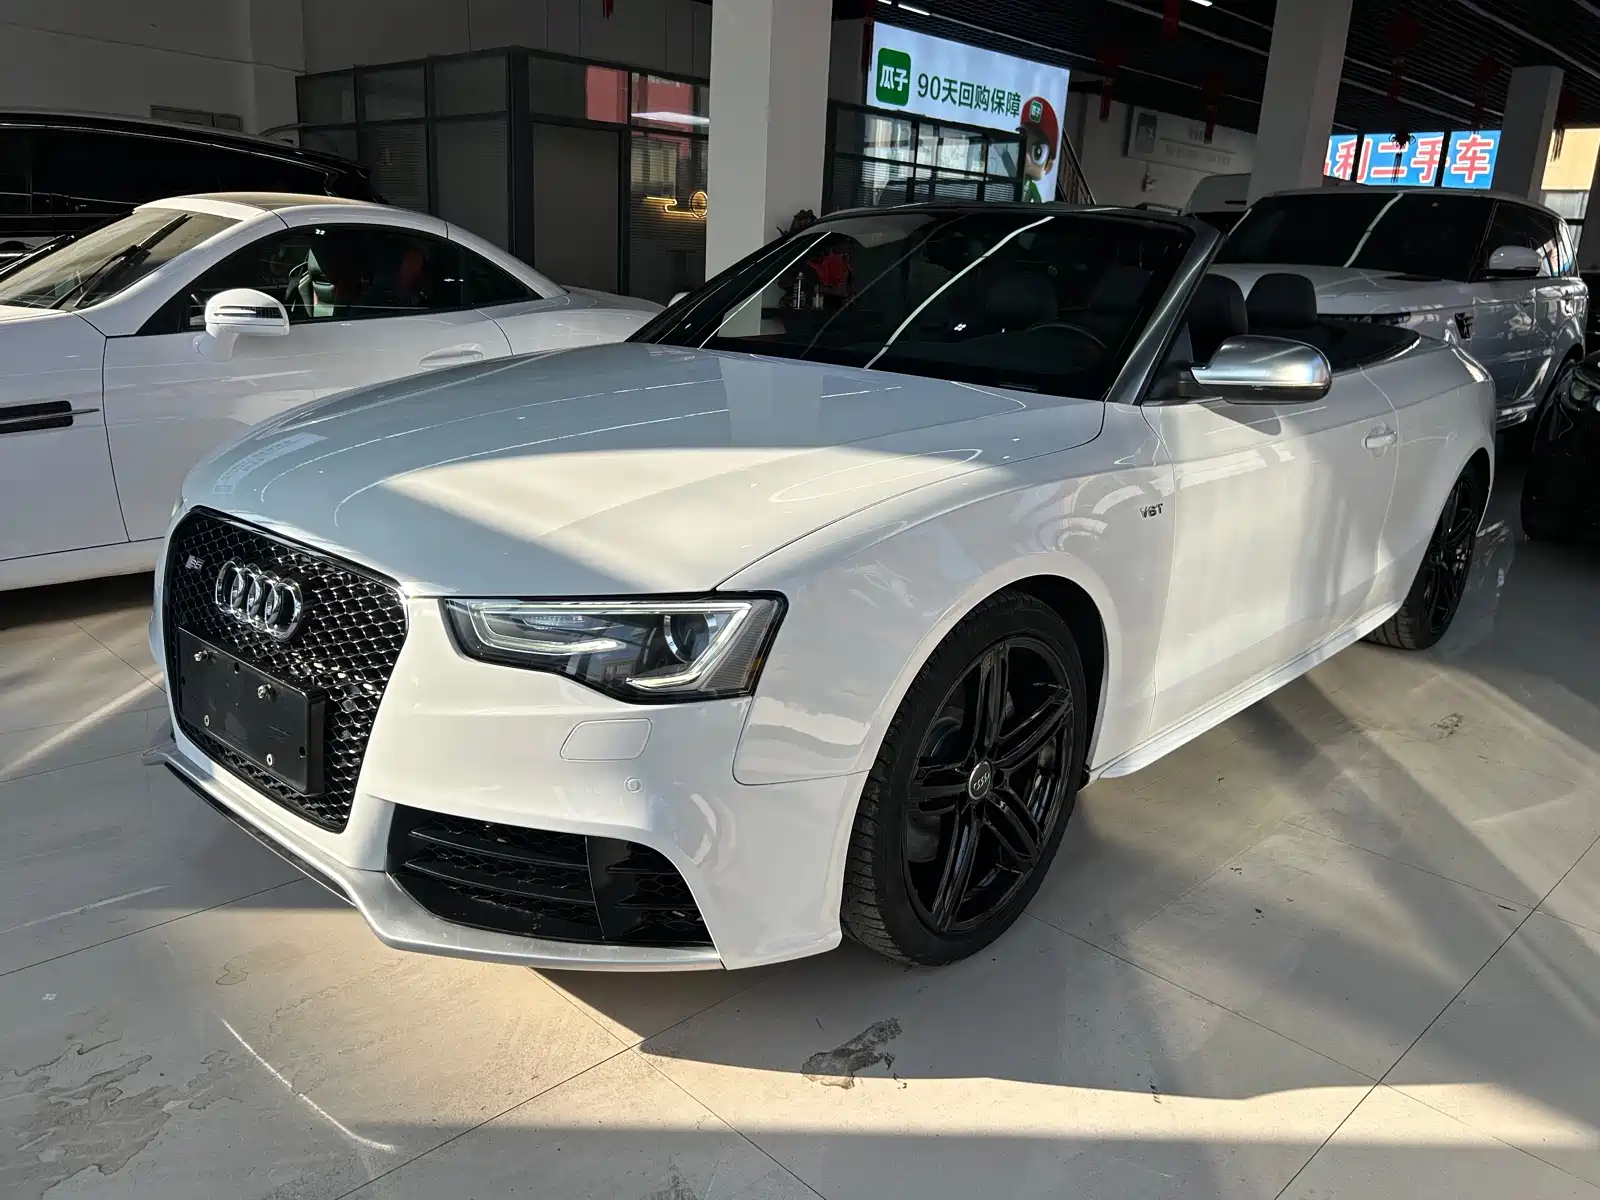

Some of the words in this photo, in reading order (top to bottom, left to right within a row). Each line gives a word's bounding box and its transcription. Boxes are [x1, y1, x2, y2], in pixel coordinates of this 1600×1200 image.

[879, 65, 909, 92] 瓜子
[917, 73, 1022, 118] 90天回购保障
[1323, 134, 1494, 184] 利二手车
[1139, 503, 1163, 518] V6T
